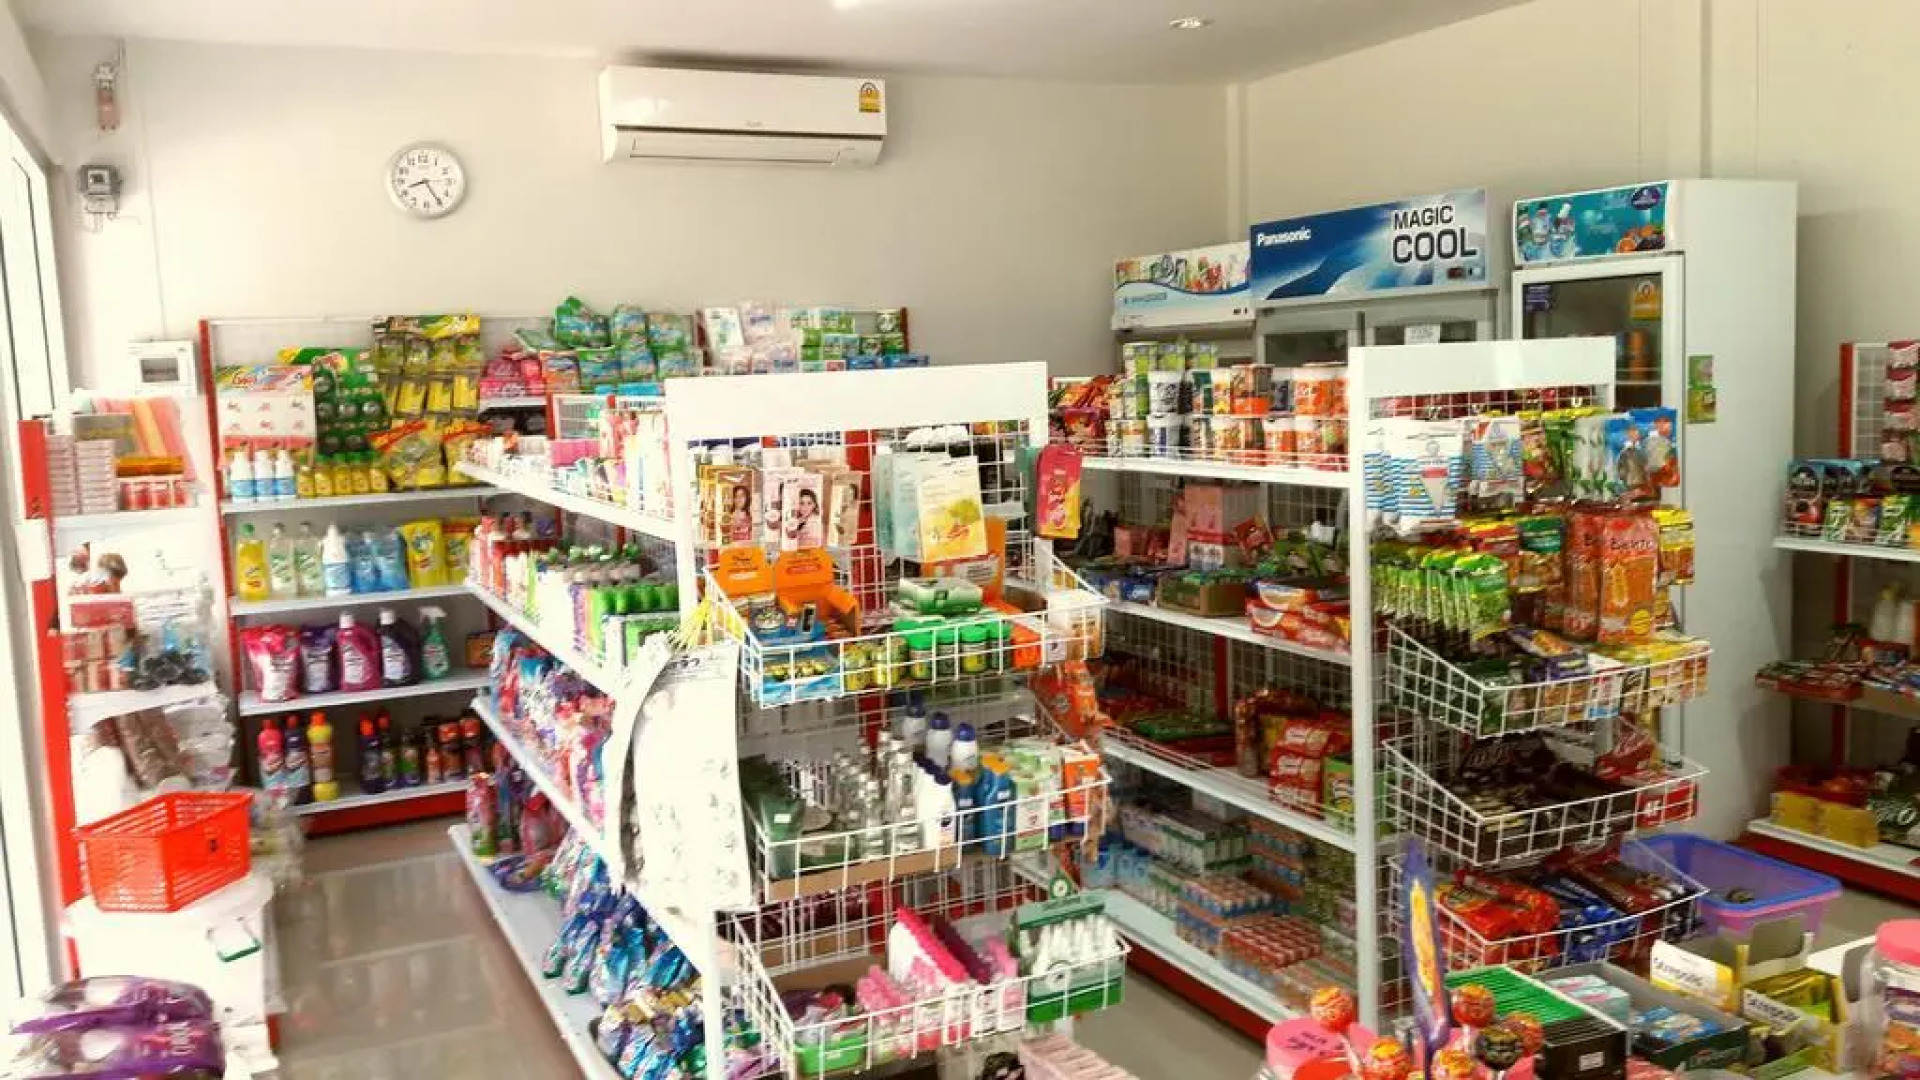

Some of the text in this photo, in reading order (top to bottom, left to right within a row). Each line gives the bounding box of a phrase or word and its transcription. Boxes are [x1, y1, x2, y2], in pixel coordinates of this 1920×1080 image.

[1394, 205, 1454, 230] MAGIC
[1256, 226, 1312, 247] Panasonic
[1392, 227, 1478, 264] COOL
